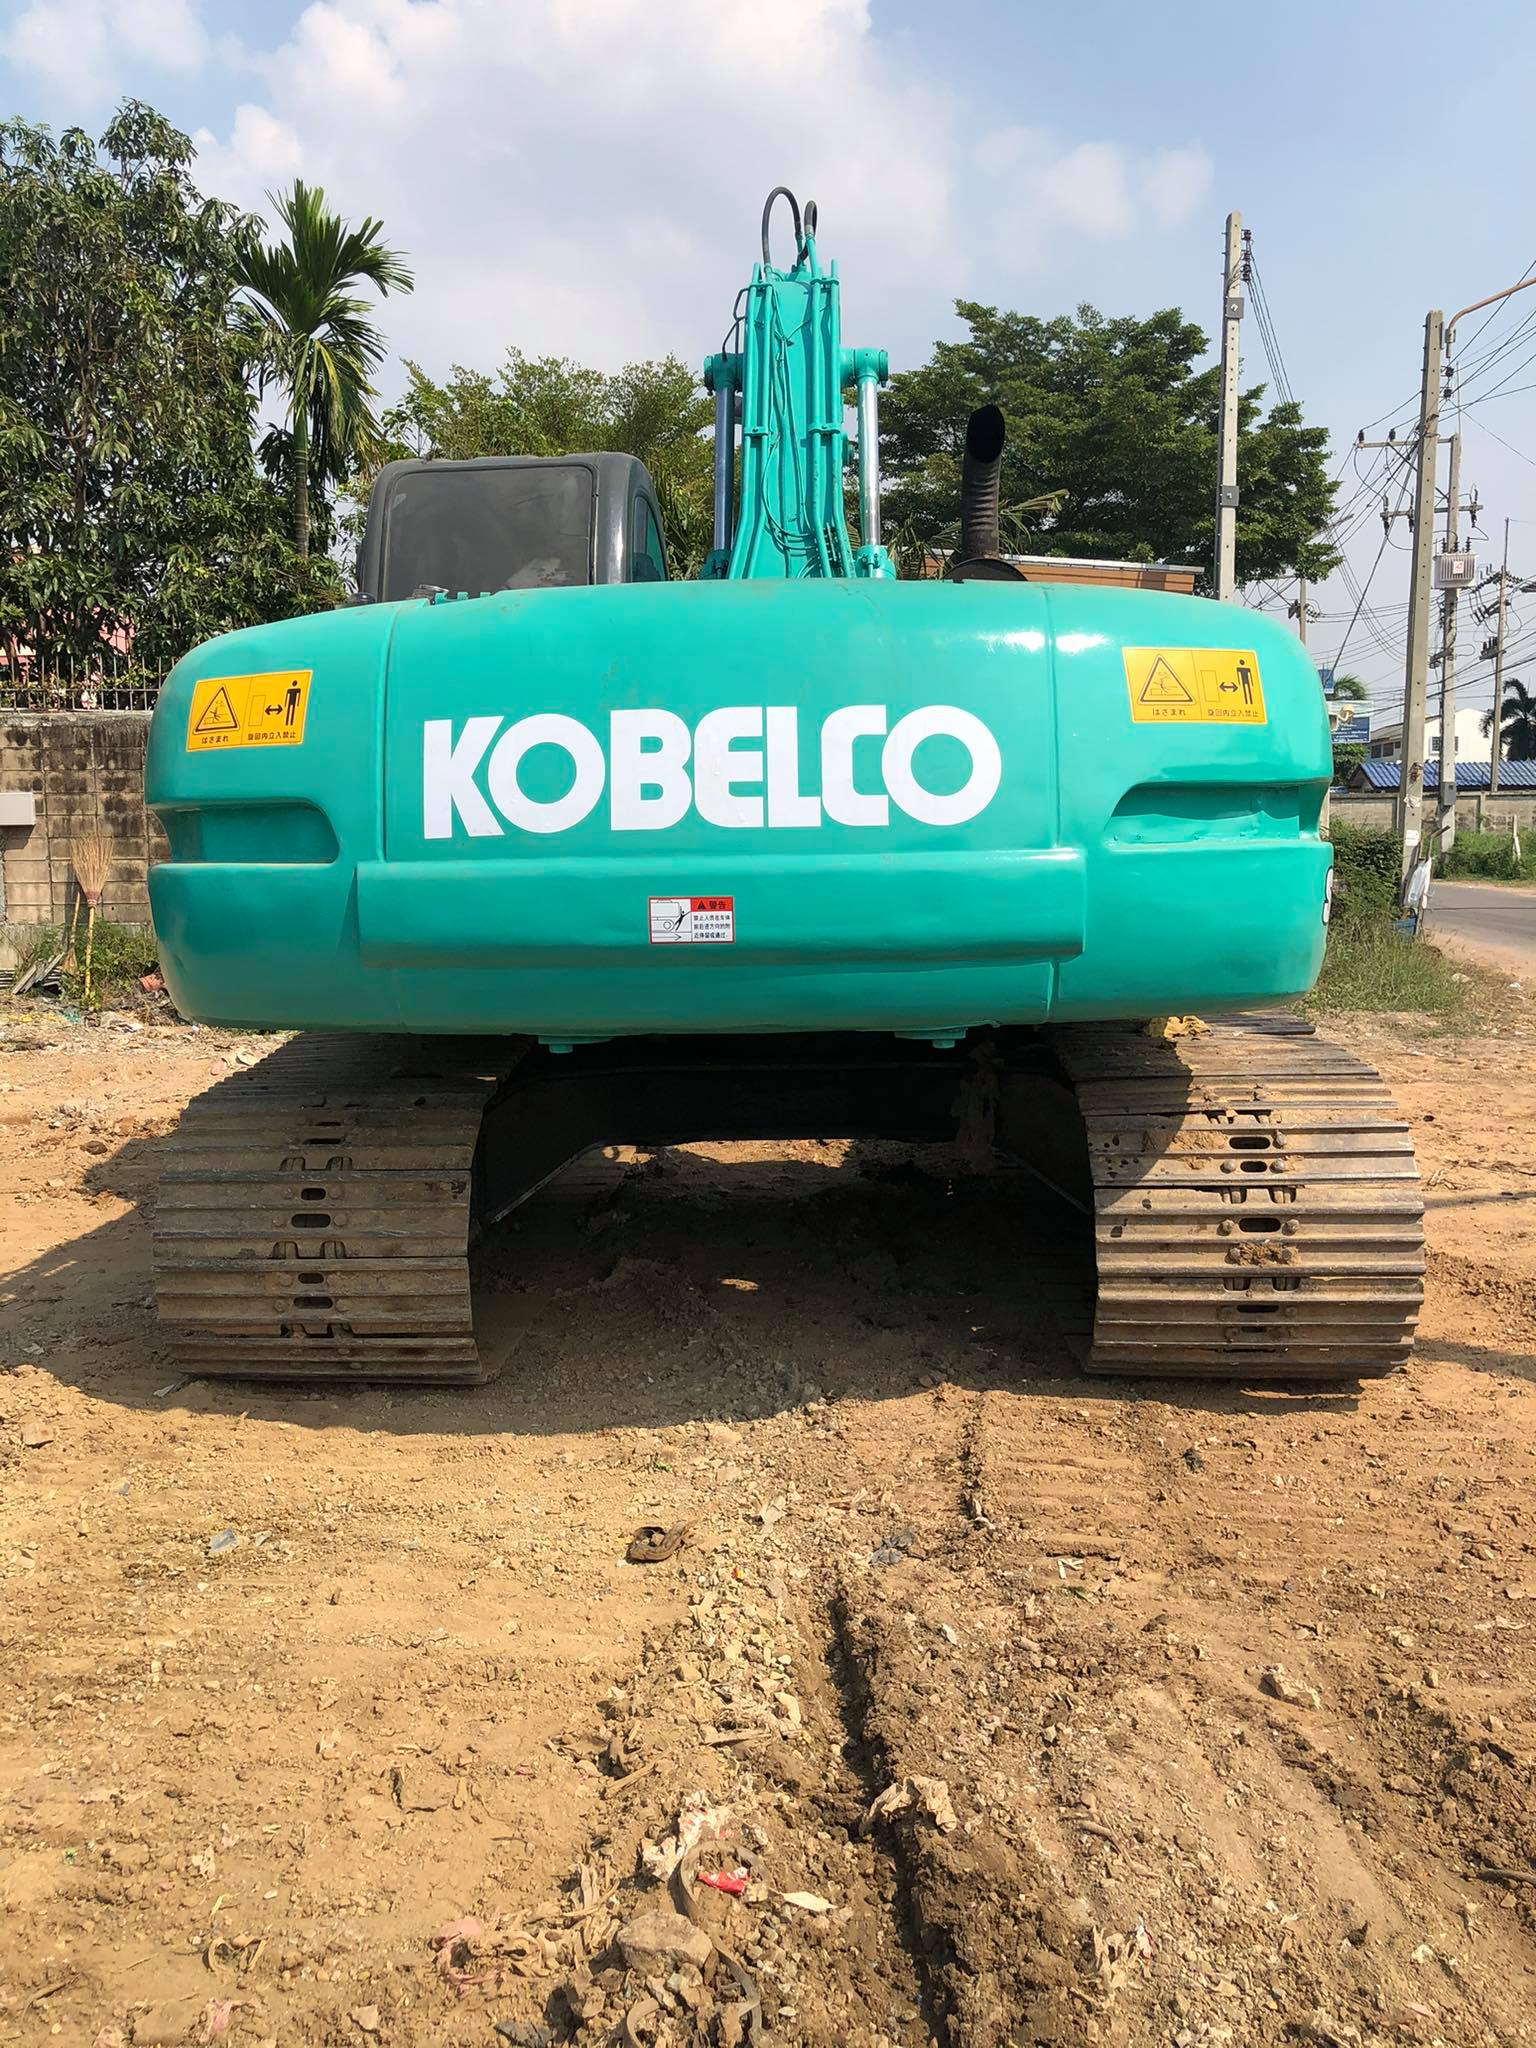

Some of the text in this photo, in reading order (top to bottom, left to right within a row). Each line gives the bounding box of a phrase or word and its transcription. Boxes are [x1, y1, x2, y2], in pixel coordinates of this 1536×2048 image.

[1152, 708, 1186, 716] はさまれ
[201, 735, 229, 744] はさまれ
[424, 704, 1002, 839] KOBELCO
[708, 900, 727, 910] 警告
